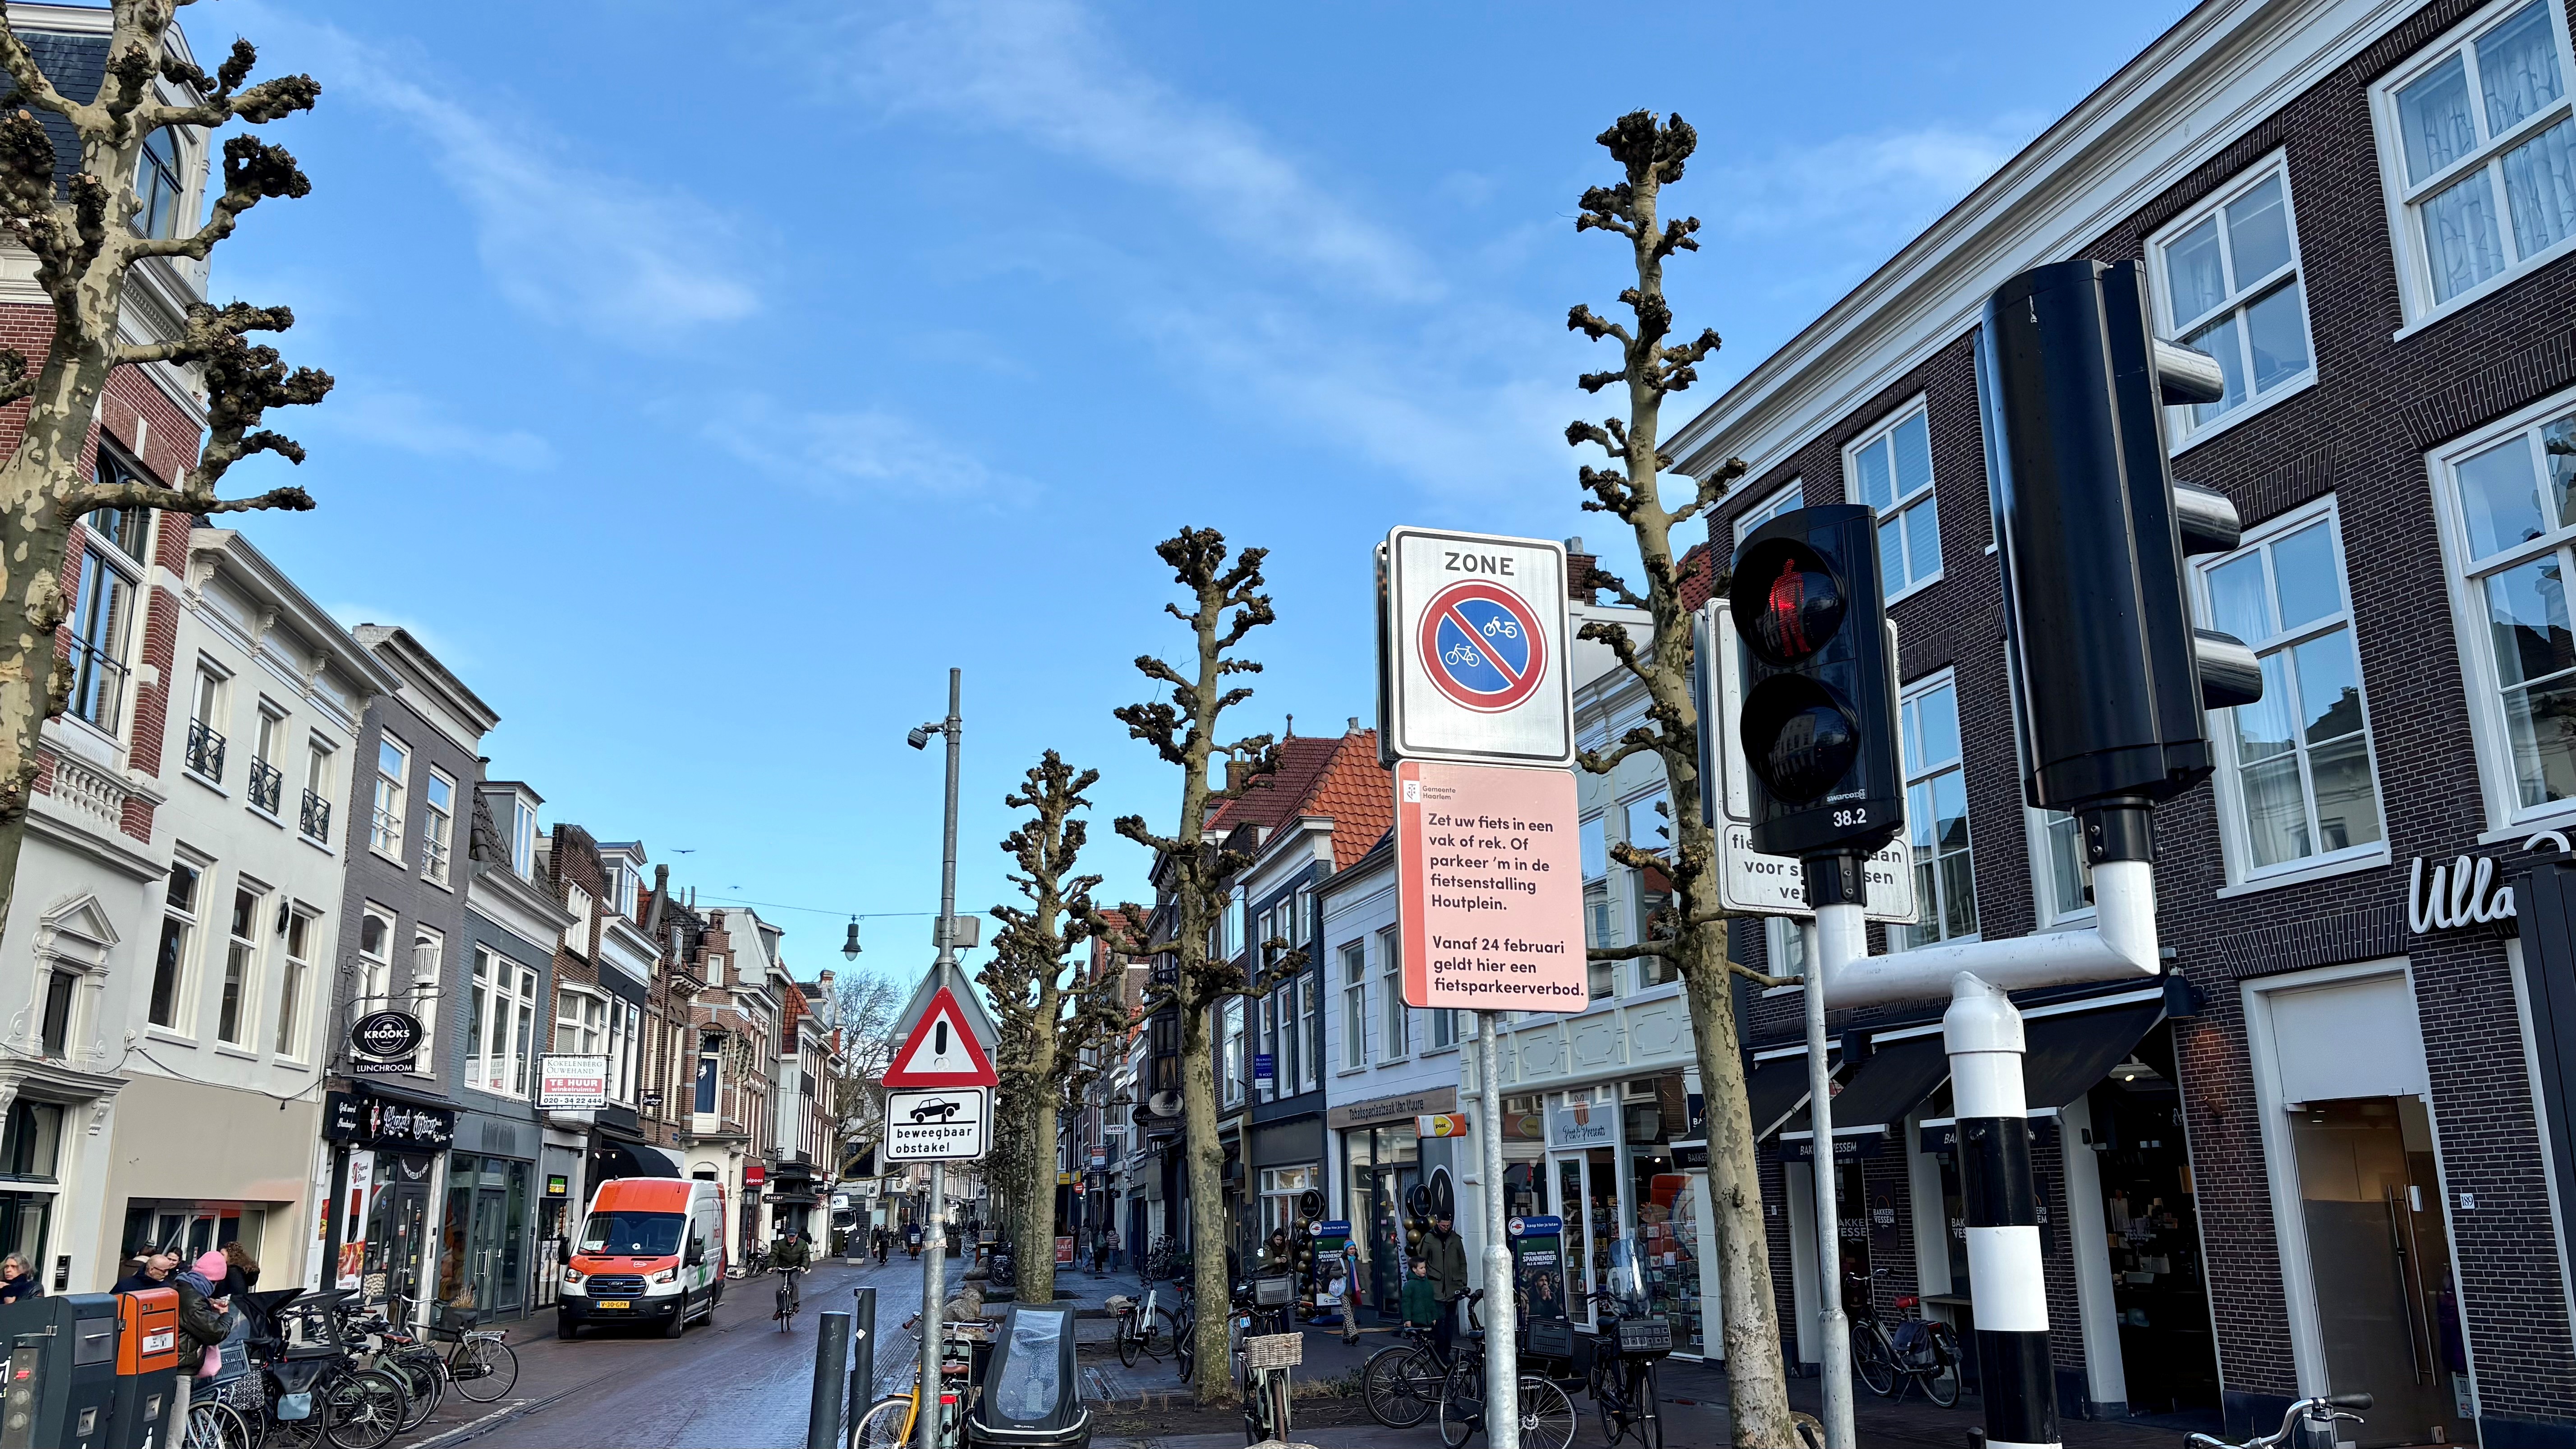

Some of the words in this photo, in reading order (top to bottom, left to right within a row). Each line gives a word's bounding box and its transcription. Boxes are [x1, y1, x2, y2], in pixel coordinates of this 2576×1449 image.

[1445, 552, 1514, 576] ZONE
[1826, 793, 1854, 802] swarco
[1428, 813, 1451, 826] Zet
[1455, 818, 1475, 828] uw
[1478, 815, 1509, 830] fiets
[1513, 817, 1525, 831] in
[1529, 821, 1553, 832] een
[1833, 808, 1867, 827] 38.2
[1429, 833, 1455, 846] vak
[1460, 835, 1474, 848] of
[1479, 836, 1506, 849] rek.
[1511, 838, 1528, 851] Of
[1430, 854, 1489, 869] parkeer
[1515, 857, 1527, 870] in
[1532, 859, 1550, 872] de
[1744, 861, 1784, 875] voor
[1431, 874, 1536, 895] fietsenstalling
[1432, 894, 1507, 912] Houtplein.
[2409, 855, 2517, 934] Ulla
[1433, 936, 1477, 950] Vanaf
[1482, 938, 1500, 951] 24
[1504, 938, 1564, 953] februari
[1434, 957, 1472, 973] geldt
[1477, 958, 1506, 972] hier
[1510, 963, 1536, 973] een
[1435, 978, 1584, 996] fietsparkeerverbod.
[364, 1030, 409, 1039] KROOKS
[1349, 1102, 1395, 1121] Tabakspeciaalzaak
[1396, 1100, 1406, 1113] Van
[1407, 1098, 1424, 1111] Vuure
[897, 1127, 972, 1140] beweegbaar
[896, 1142, 949, 1153] obstakel
[2461, 1196, 2473, 1206] 189
